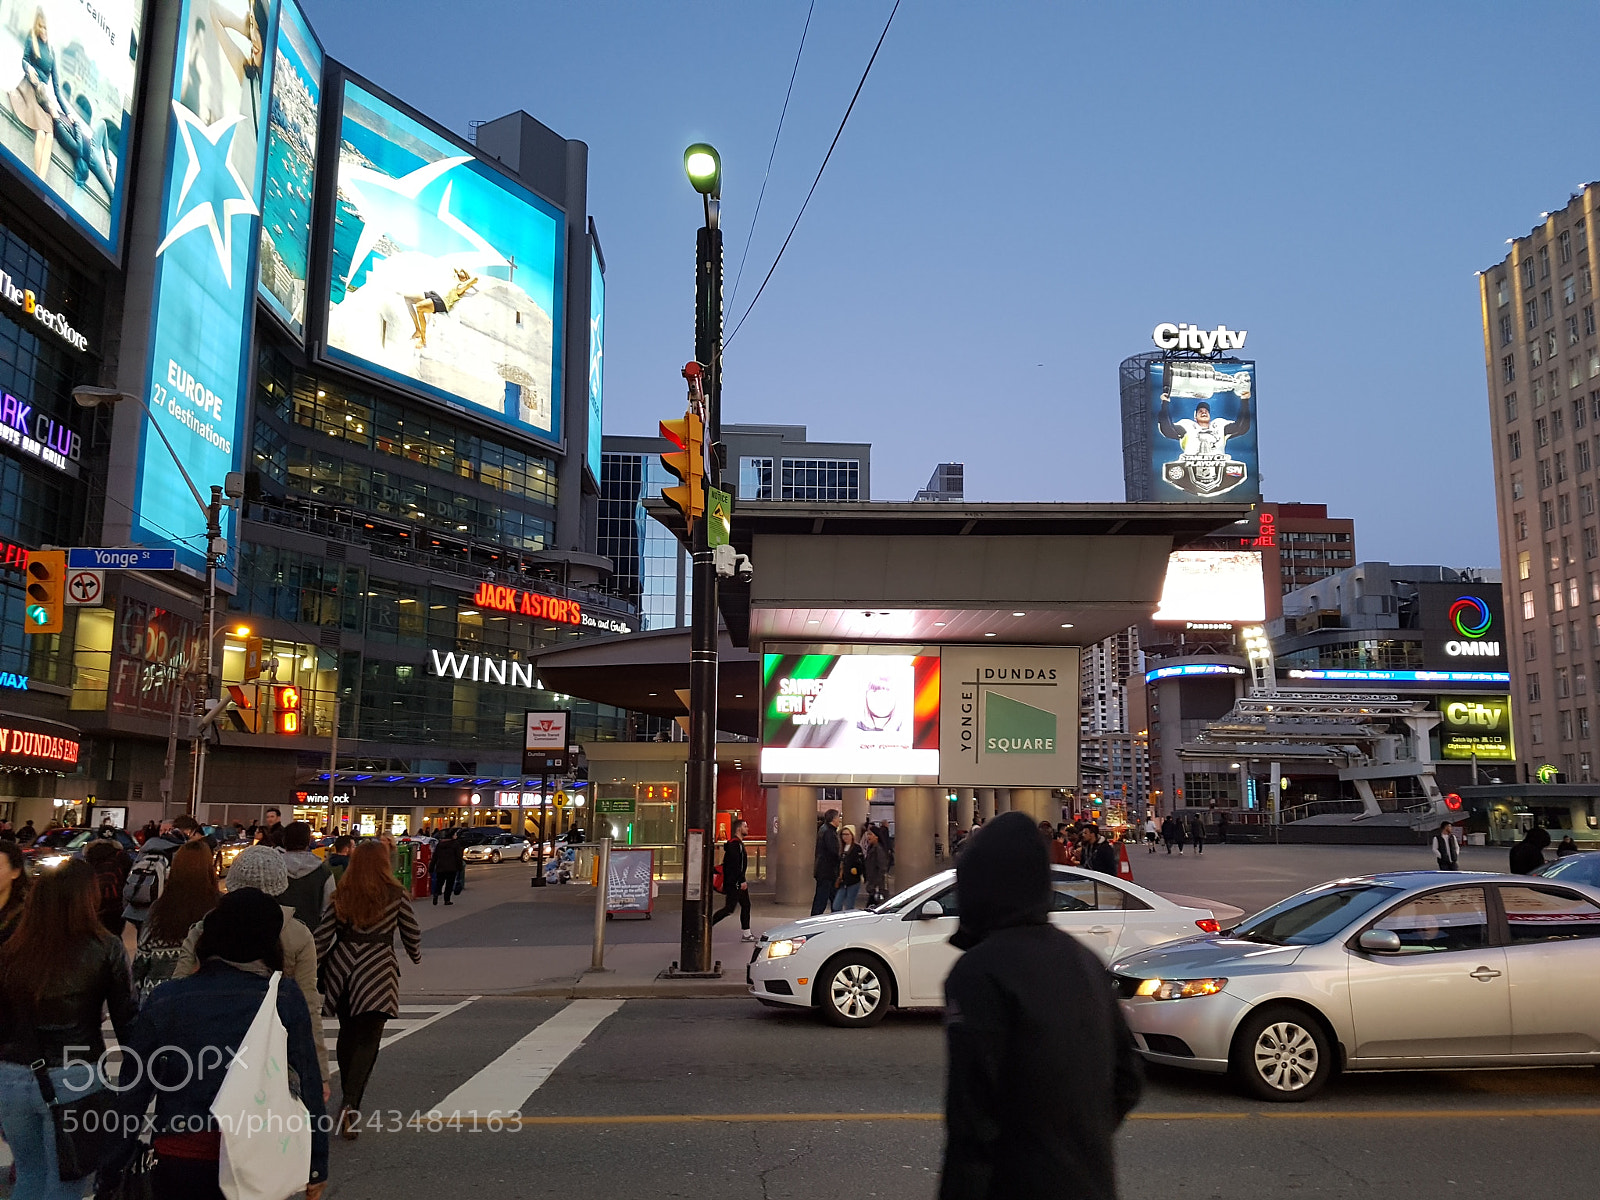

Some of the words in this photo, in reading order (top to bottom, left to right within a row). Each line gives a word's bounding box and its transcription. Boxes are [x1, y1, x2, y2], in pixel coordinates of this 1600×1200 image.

[86, 2, 116, 46] calling
[0, 268, 24, 306] The
[23, 289, 57, 330] Beer
[55, 313, 88, 352] Store
[1153, 323, 1248, 355] Citytv
[167, 358, 223, 422] EUROPE
[36, 413, 81, 461] CLUB
[153, 383, 167, 407] 27
[168, 397, 231, 454] destinations
[94, 550, 139, 568] Yonge
[142, 551, 151, 559] St
[475, 582, 517, 613] JACK
[520, 591, 581, 626] ASTOR'S
[581, 613, 596, 627] Bar
[597, 619, 609, 630] and
[1445, 640, 1500, 657] OMNI
[432, 648, 545, 690] WINN
[984, 668, 1057, 680] DUNDAS
[961, 692, 973, 752] YONGE
[1447, 702, 1502, 730] City
[11, 730, 64, 760] DUNDAS
[63, 739, 79, 763] EAST
[988, 738, 1054, 753] SQUARE
[307, 793, 350, 803] wineack
